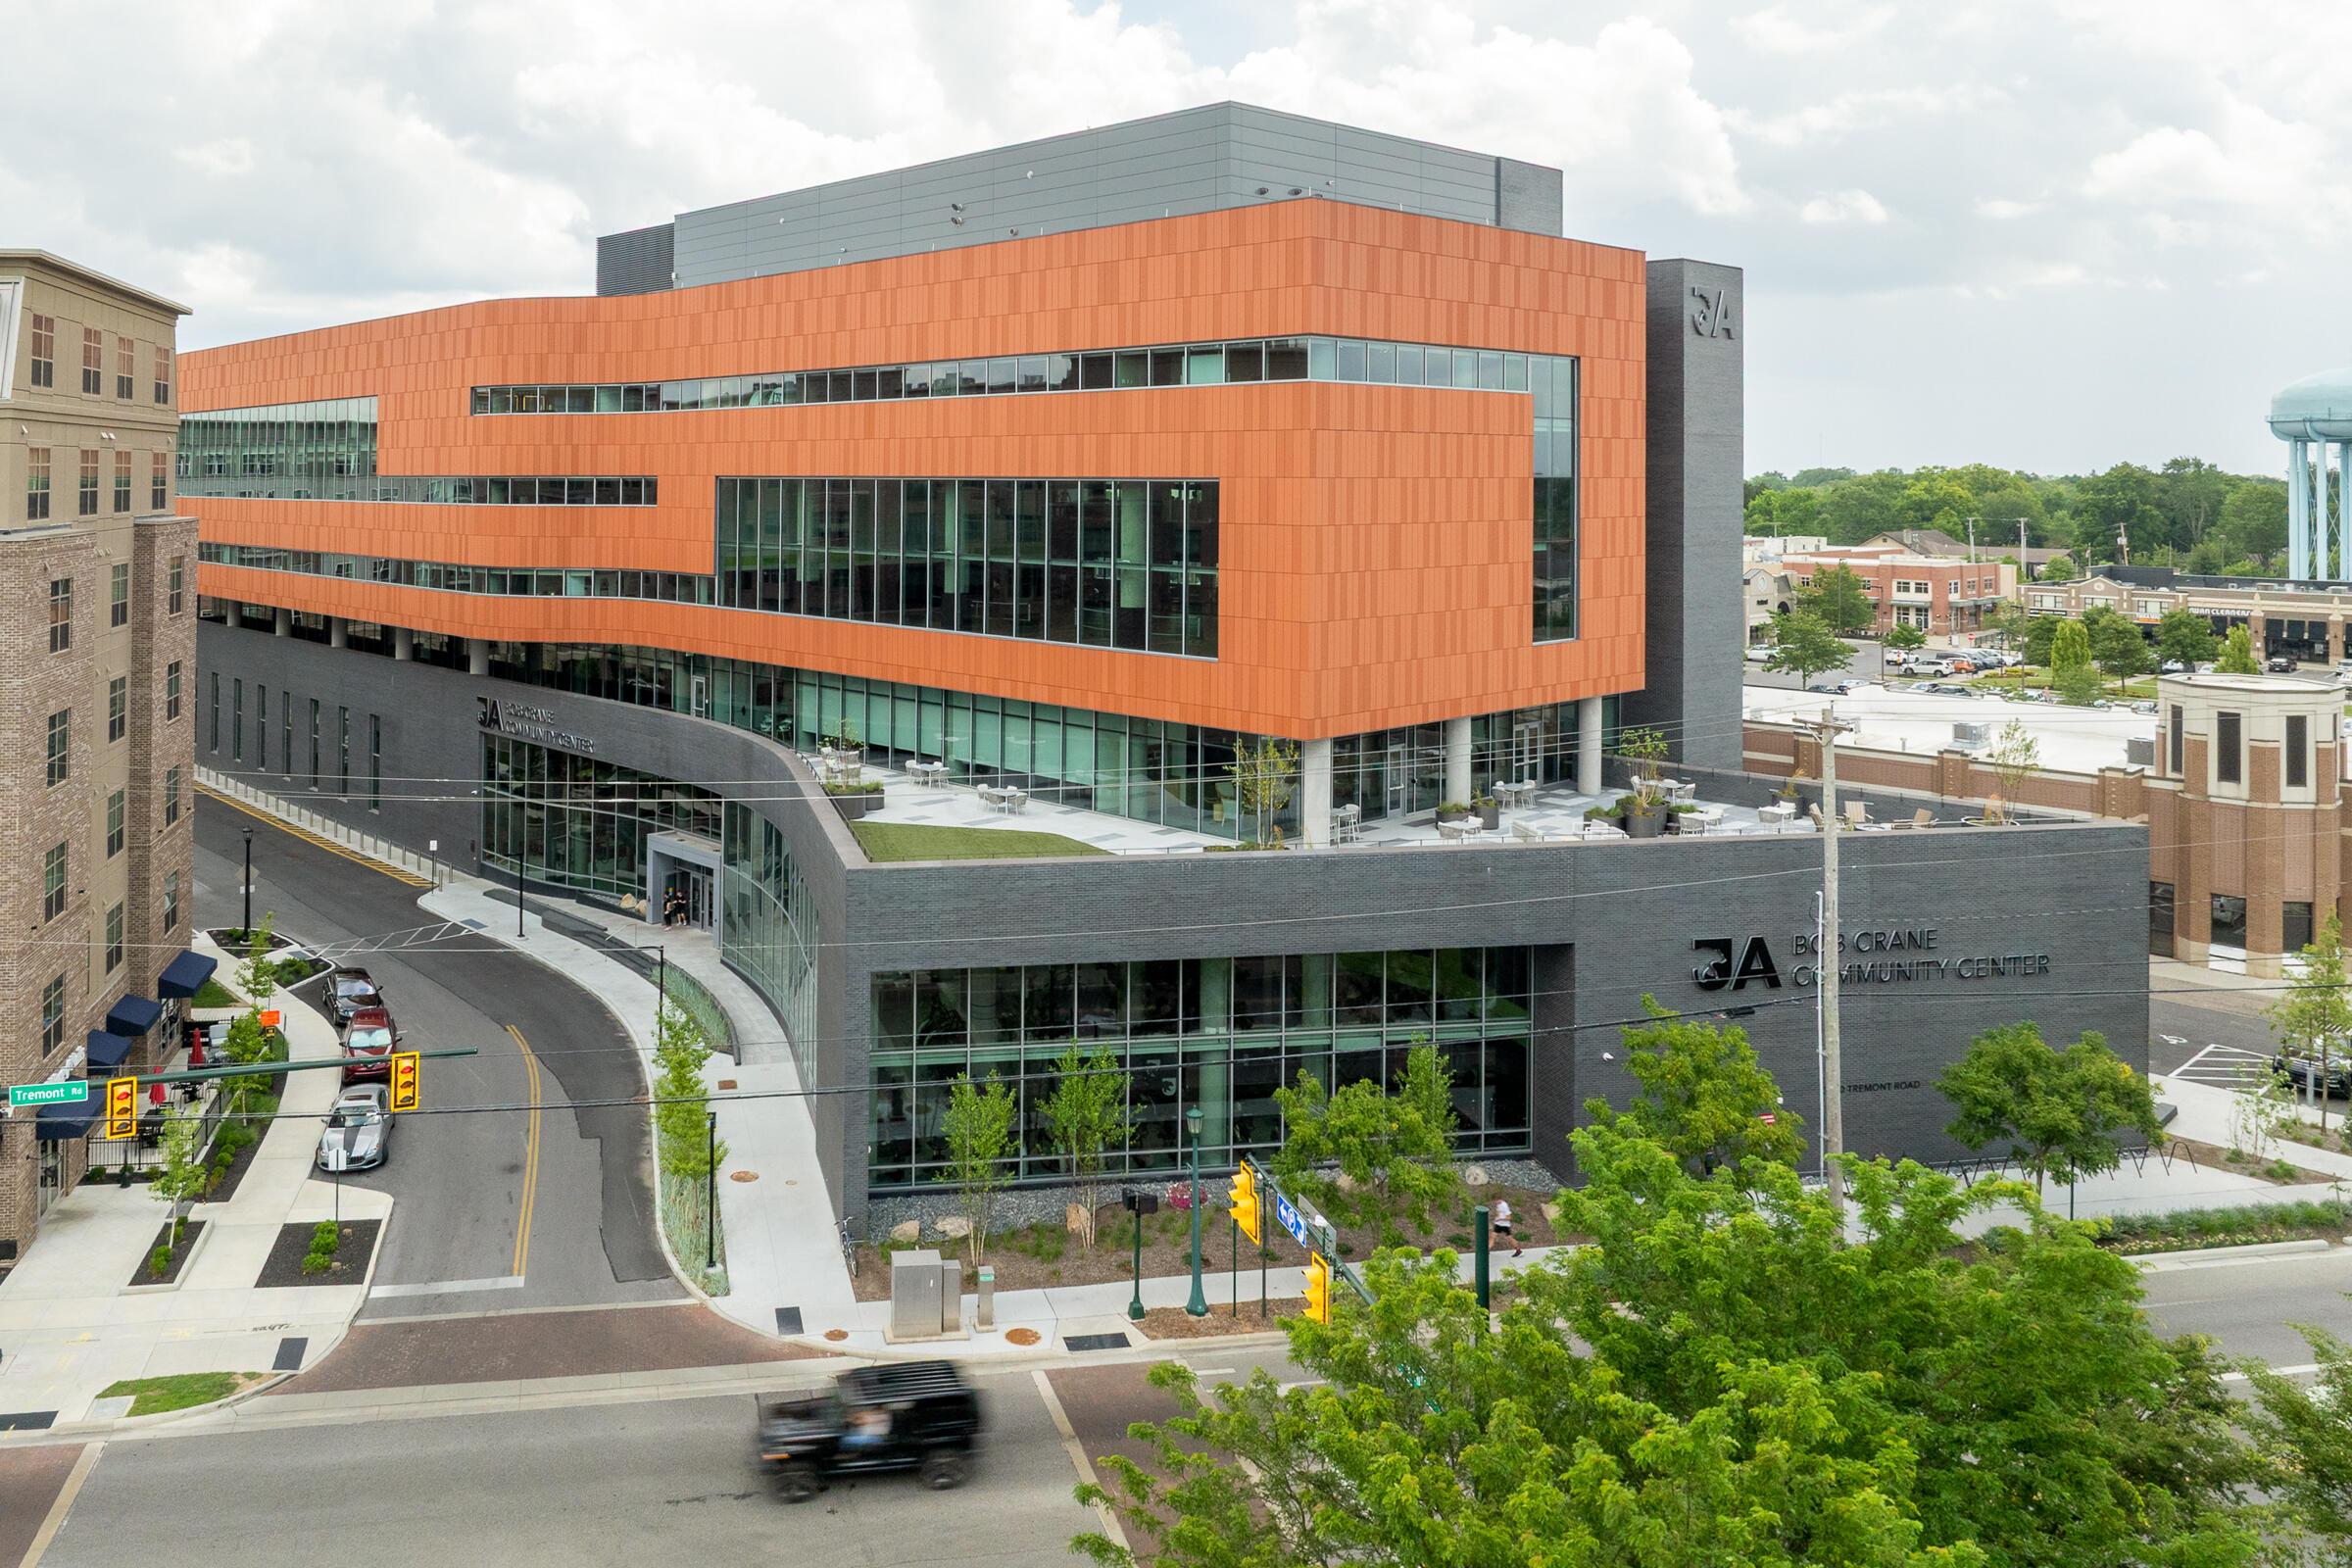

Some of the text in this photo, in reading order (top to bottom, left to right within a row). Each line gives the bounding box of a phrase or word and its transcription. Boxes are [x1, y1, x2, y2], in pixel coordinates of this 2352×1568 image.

[524, 706, 556, 724] CRANE
[506, 720, 594, 754] COMMUNITY CENTER
[1854, 928, 1938, 953] CRANE
[1956, 954, 2050, 979] CENTER
[16, 1087, 83, 1101] Tremont Rd
[1847, 1082, 1891, 1093] TREMONT
[1893, 1080, 1921, 1091] ROAD
